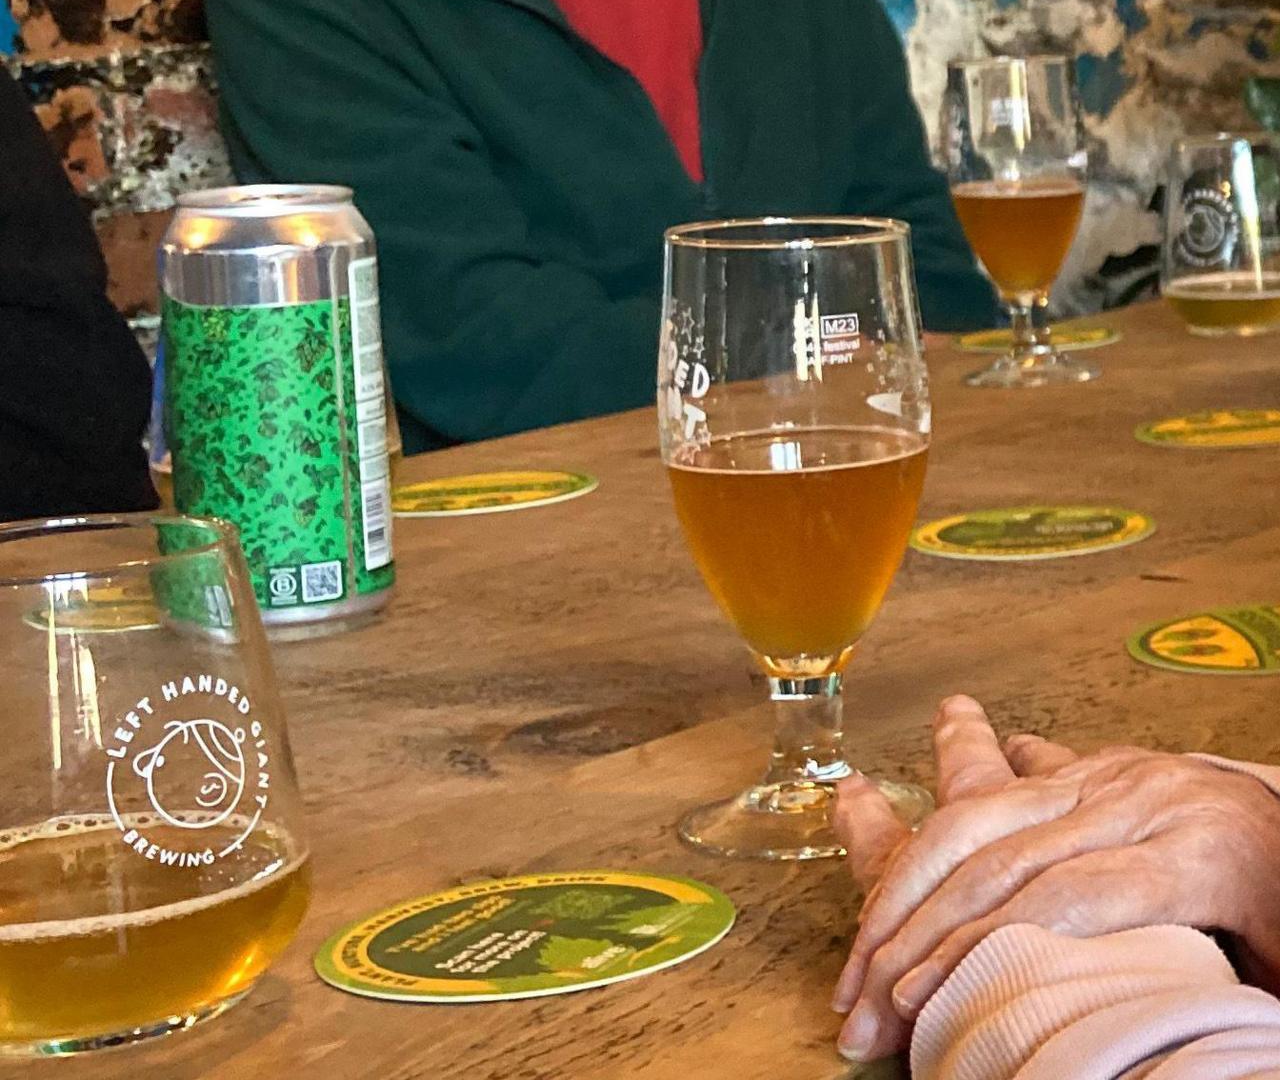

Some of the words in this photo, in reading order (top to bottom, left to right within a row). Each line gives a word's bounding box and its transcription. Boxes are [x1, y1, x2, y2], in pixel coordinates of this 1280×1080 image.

[825, 318, 856, 334] M23
[106, 696, 154, 759] LEFT
[161, 674, 250, 714] HANDED
[251, 720, 270, 809] GIANT
[123, 829, 215, 867] BREWING
